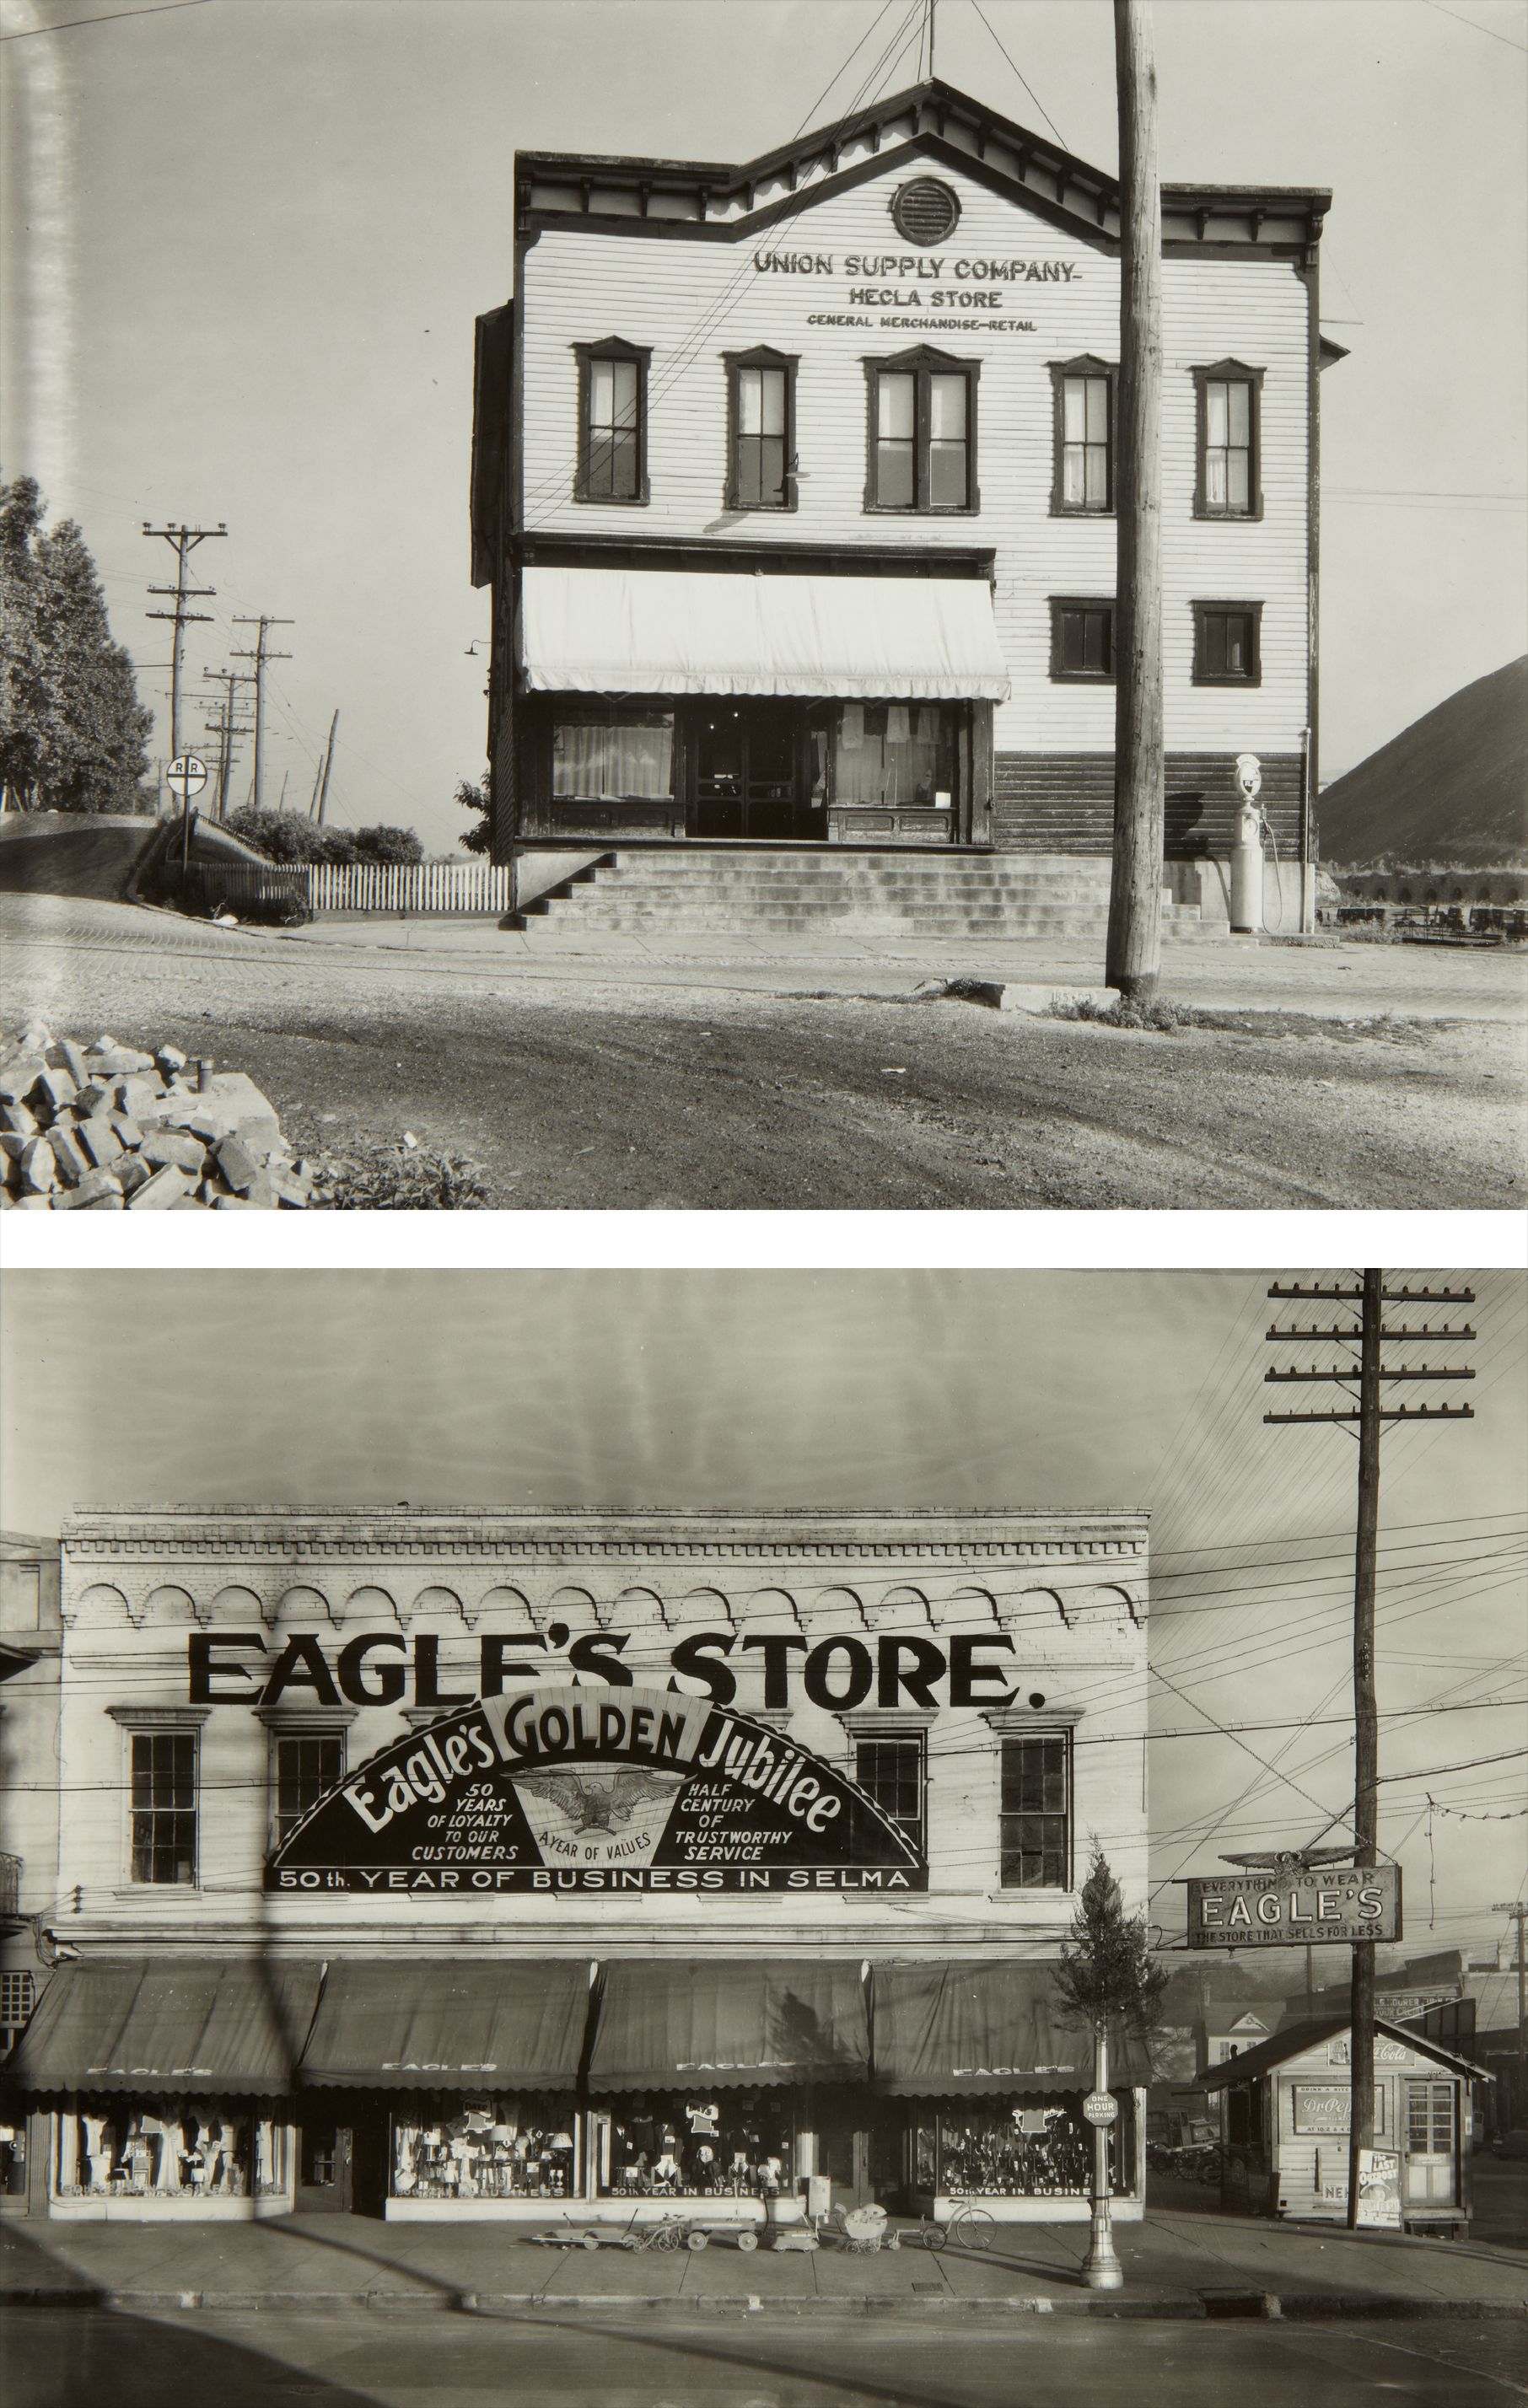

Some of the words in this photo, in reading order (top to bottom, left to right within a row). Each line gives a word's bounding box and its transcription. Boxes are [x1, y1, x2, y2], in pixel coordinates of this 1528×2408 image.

[755, 253, 832, 274] UNION
[845, 255, 944, 279] SUPPLY
[849, 288, 922, 306] HECLA
[932, 291, 1003, 309] STORE
[807, 314, 874, 328] GENERAL
[189, 1622, 632, 1707] EAGLE'S
[342, 1725, 494, 1834] Eagle's
[504, 1694, 686, 1758] GOLDEN
[699, 1719, 841, 1832] Jubilee
[465, 1784, 493, 1798] 50
[688, 1783, 733, 1797] HALF
[455, 1798, 506, 1812] YEARS
[681, 1798, 756, 1813] CENTURY
[428, 1814, 446, 1828] OF
[449, 1814, 514, 1828] LOYALTY
[699, 1814, 724, 1828] OF
[445, 1831, 461, 1843] TO
[468, 1830, 499, 1843] OUR
[675, 1830, 793, 1844] TRUSTWORTHY
[539, 1830, 549, 1846] A
[550, 1836, 578, 1857] YEAR
[584, 1847, 600, 1860] OF
[606, 1832, 651, 1859] VALUES
[412, 1846, 519, 1861] CUSTOMERS
[684, 1846, 763, 1861] SERVICE
[360, 1871, 460, 1888] YEAR
[471, 1871, 514, 1888] OF
[533, 1871, 724, 1888] BUSINESS
[740, 1871, 770, 1888] IN
[788, 1870, 910, 1888] SELMA
[1295, 1876, 1314, 1887] TO
[1322, 1873, 1375, 1886] WEAR
[1201, 1887, 1383, 1927] EAGLE'S
[1195, 1931, 1217, 1943] THE
[1219, 1931, 1254, 1942] STORE
[1256, 1928, 1283, 1941] THAT
[1288, 1927, 1324, 1938] SELLS
[1326, 1924, 1348, 1938] FOR
[1087, 2103, 1114, 2111] HOUR
[1373, 2159, 1396, 2172] LAST
[1359, 2169, 1397, 2185] OUTPOST
[643, 2187, 675, 2196] YEAR
[684, 2187, 697, 2196] IN
[705, 2187, 780, 2196] BUSNESS
[977, 2187, 1006, 2196] YEAR
[1034, 2187, 1114, 2196] BUSINES
